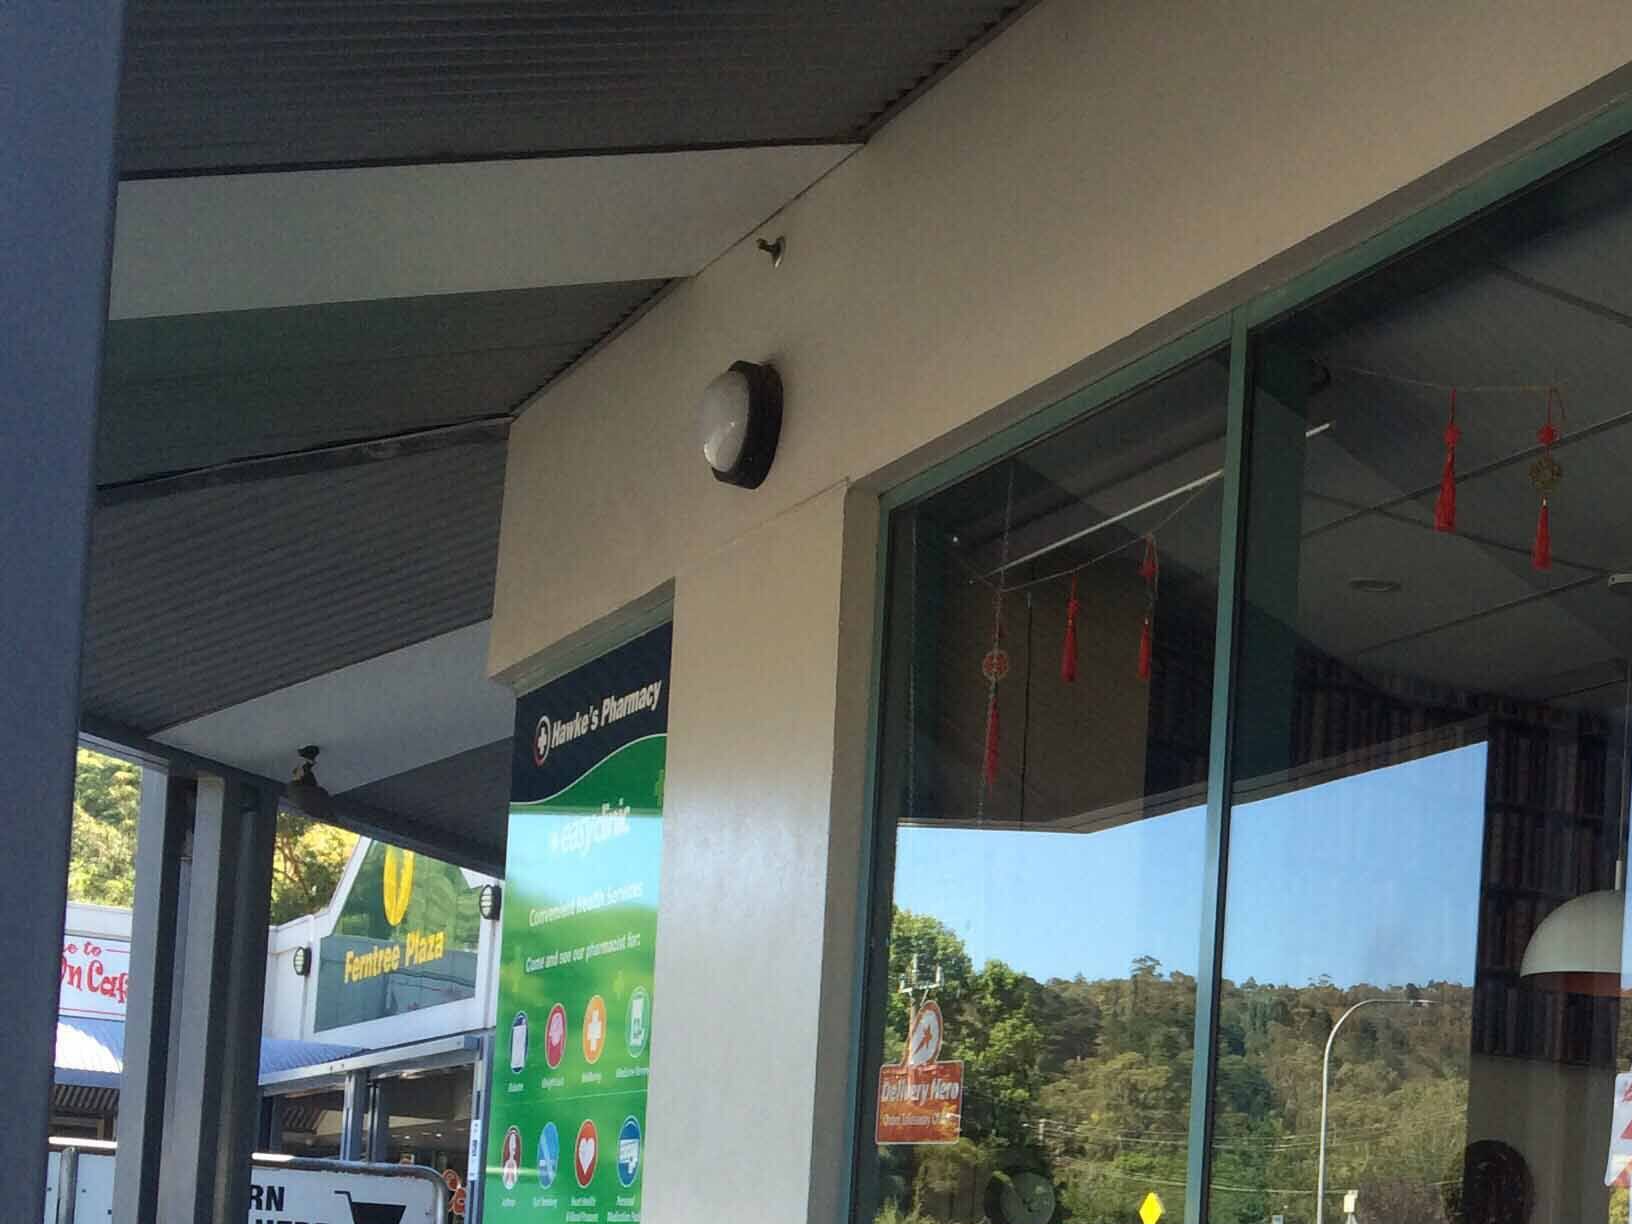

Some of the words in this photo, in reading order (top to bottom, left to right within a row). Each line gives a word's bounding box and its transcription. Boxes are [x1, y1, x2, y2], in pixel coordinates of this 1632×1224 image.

[551, 705, 599, 749] Hawke's
[600, 680, 662, 727] Pharmacy
[84, 942, 102, 957] to
[344, 945, 401, 985] Ferntree
[404, 929, 446, 968] Plaza
[545, 950, 559, 968] and
[87, 959, 128, 1004] Caf
[930, 1078, 960, 1100] Hero
